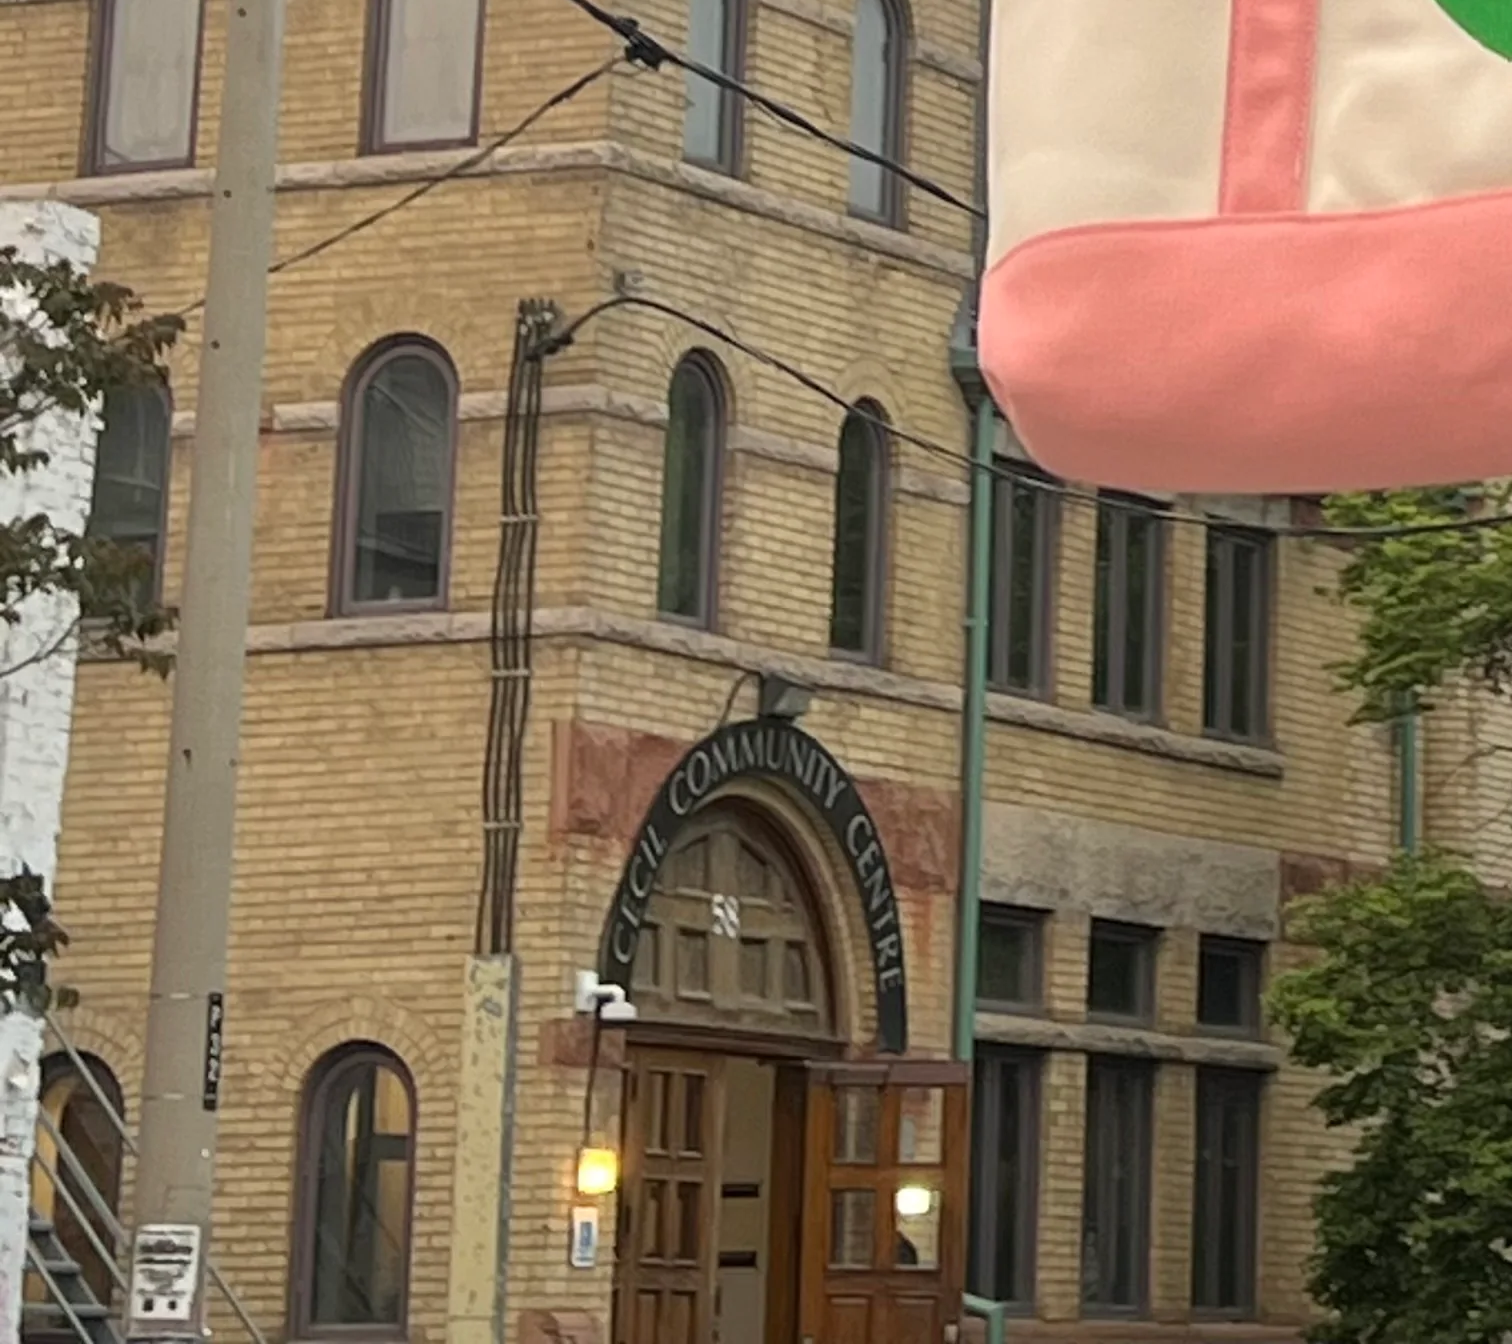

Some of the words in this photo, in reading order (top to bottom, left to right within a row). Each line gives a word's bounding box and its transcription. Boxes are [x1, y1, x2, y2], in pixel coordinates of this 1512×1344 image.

[612, 825, 667, 964] CECIL
[669, 731, 848, 815] COMMUNITY
[845, 814, 903, 991] CENTRE
